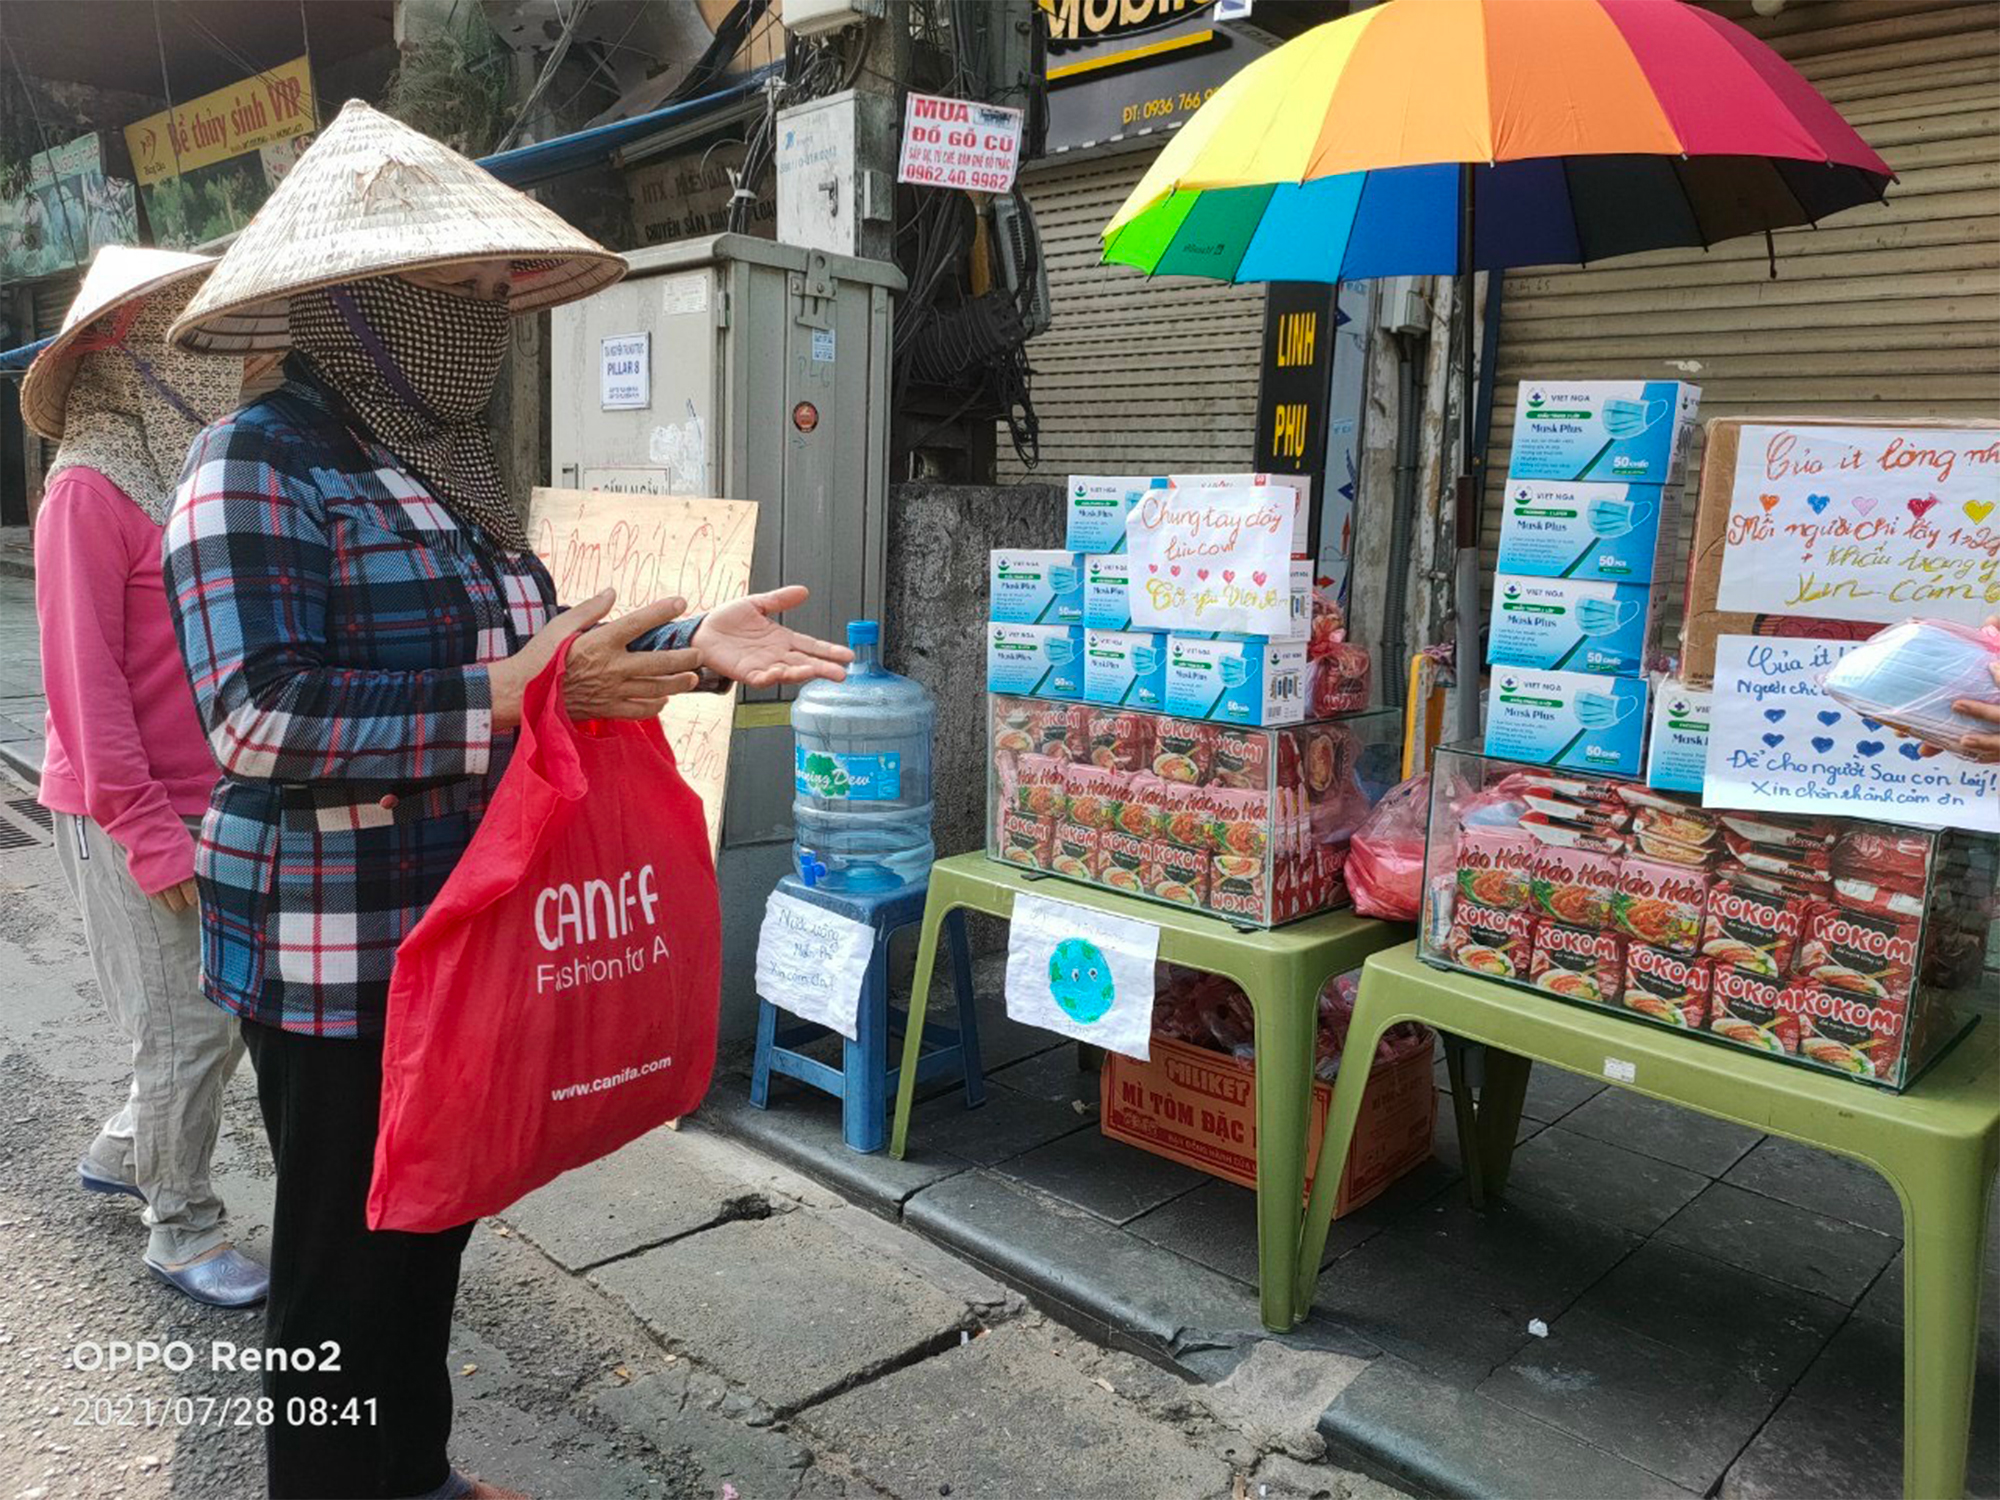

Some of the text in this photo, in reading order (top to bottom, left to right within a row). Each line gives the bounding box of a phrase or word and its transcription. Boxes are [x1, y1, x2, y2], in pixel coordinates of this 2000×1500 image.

[192, 107, 227, 149] thủy
[231, 91, 267, 136] sinh
[266, 76, 300, 122] VIP
[914, 98, 969, 123] MUA
[1122, 92, 1201, 124] ĐT: 0936 766
[948, 127, 977, 148] GỖ
[984, 134, 1013, 152] CŨ
[906, 163, 1009, 190] 0962.40.9982
[644, 216, 681, 241] CHUYÊN
[1277, 312, 1317, 367] LINH
[607, 360, 640, 376] PILLAR 8
[1551, 394, 1590, 402] VIET NGA
[1273, 404, 1308, 469] PHỤ
[1531, 423, 1583, 433] Mask Plus
[1613, 456, 1629, 467] 50
[1767, 430, 1825, 481] Của
[1840, 446, 1866, 470] ít
[1877, 437, 1956, 482] lòng
[1537, 492, 1553, 500] VIET
[1142, 497, 1200, 537] Chung
[1203, 506, 1241, 542] tay
[1518, 520, 1567, 531] Mask Plus
[1599, 555, 1614, 566] 50
[1526, 588, 1564, 598] VIET NGA
[1508, 615, 1557, 627] Mask Plus
[1588, 652, 1602, 662] 50
[1747, 645, 1803, 676] Của
[1810, 644, 1832, 667] ít
[1505, 707, 1555, 720] Mask Plus
[1673, 734, 1702, 745] Mask
[831, 768, 870, 786] Dew
[1726, 748, 1765, 769] Để
[1767, 752, 1808, 774] cho
[1812, 754, 1865, 786] người
[1911, 766, 1952, 787] còn
[1751, 780, 1791, 797] Xin
[1936, 793, 1964, 807] ơn
[1056, 823, 1098, 848] KOKOM
[1102, 832, 1151, 861] KOKOM
[1153, 841, 1208, 873] KOKOM
[1533, 857, 1574, 884] Hảo
[1613, 870, 1704, 906] Hảo Hảo
[1535, 925, 1619, 961] KOKOMI
[537, 956, 623, 994] Fashion
[626, 946, 645, 975] for
[1627, 943, 1710, 991] KOKOMI
[552, 1056, 671, 1101] www.canifa.com
[1167, 1057, 1250, 1107] MILIKET
[1122, 1076, 1143, 1108] MÌ
[1149, 1093, 1194, 1128] TÔM
[1202, 1110, 1244, 1144] ĐẶC
